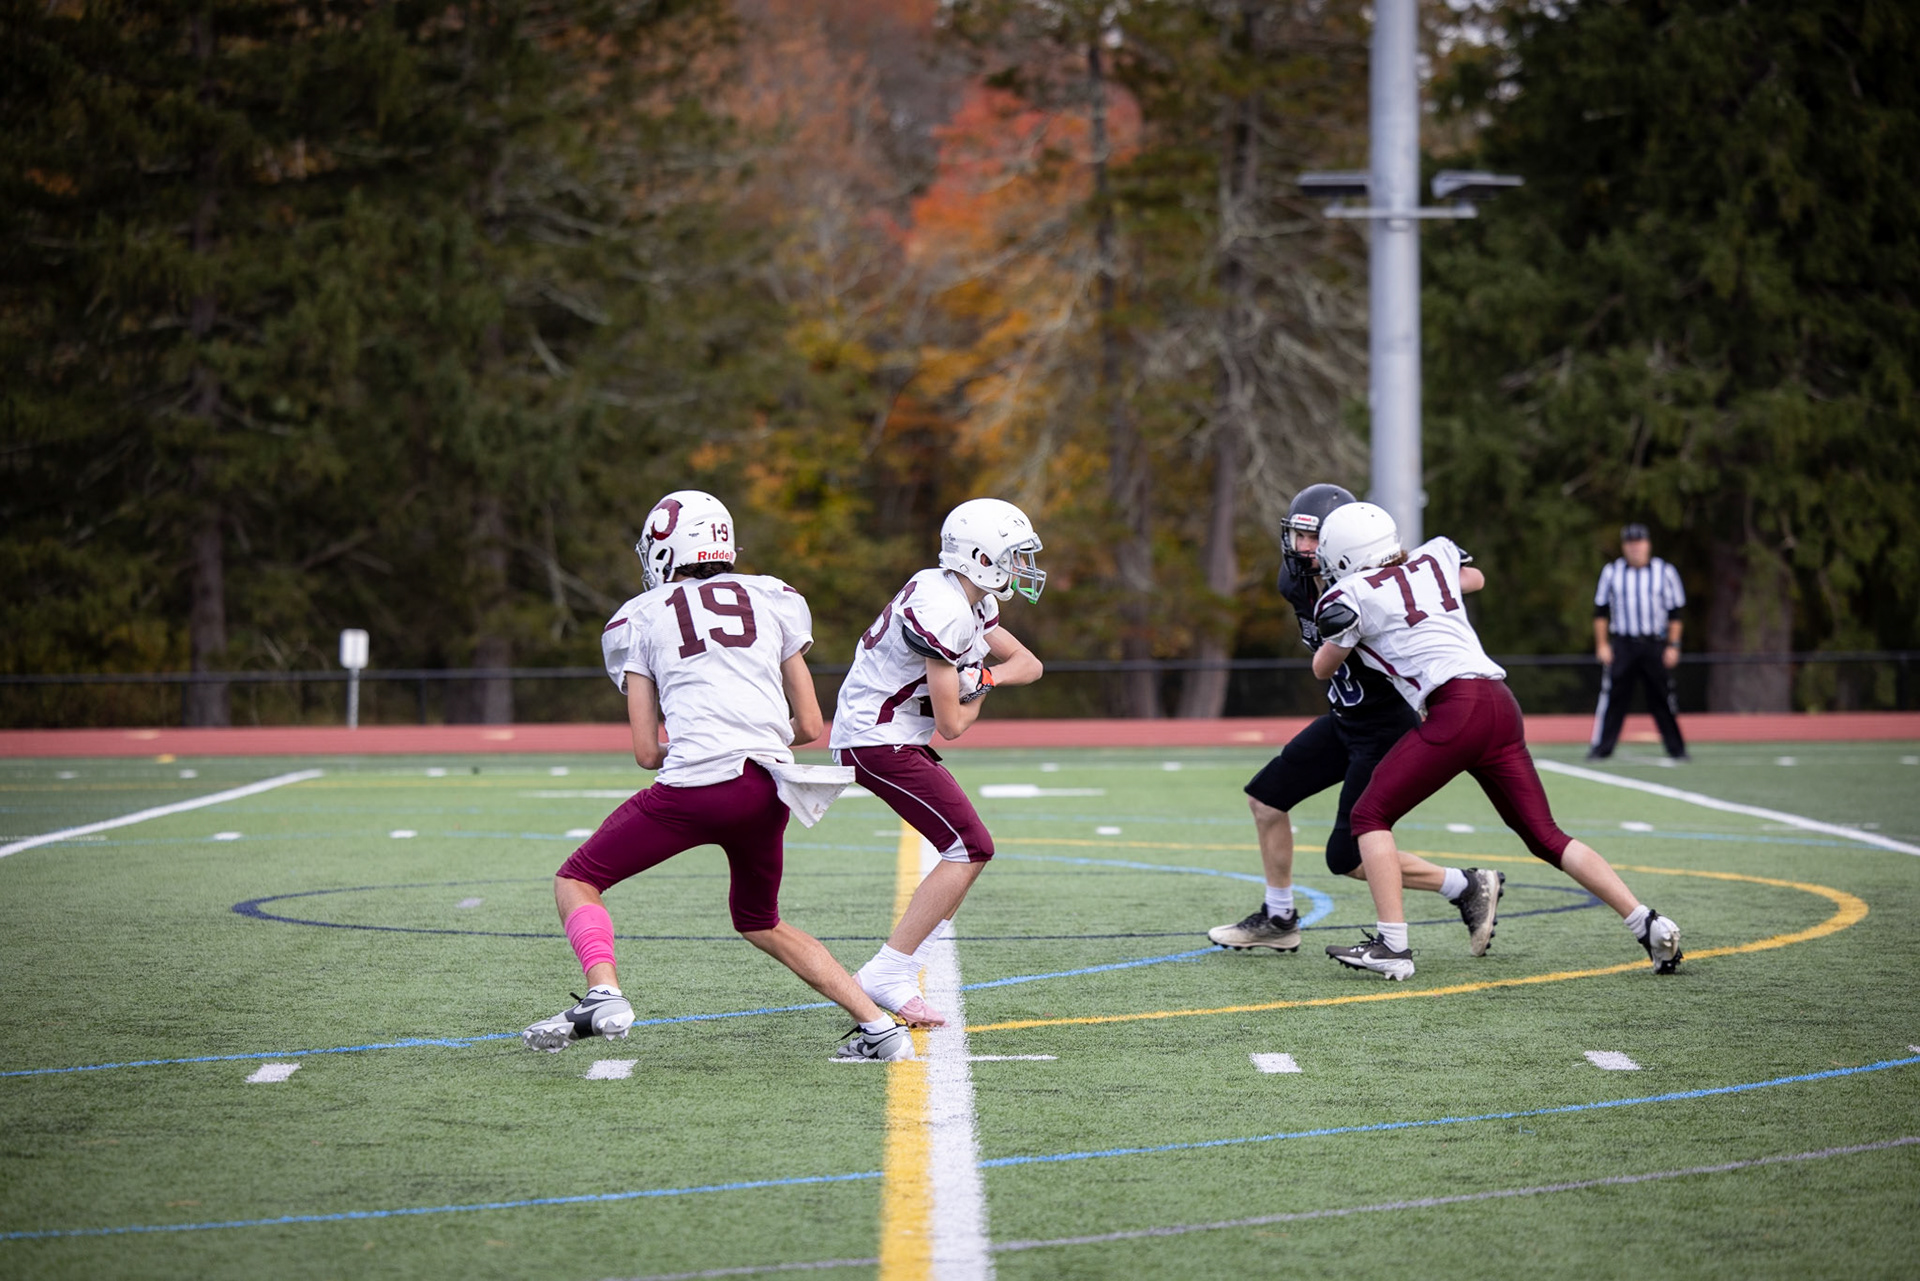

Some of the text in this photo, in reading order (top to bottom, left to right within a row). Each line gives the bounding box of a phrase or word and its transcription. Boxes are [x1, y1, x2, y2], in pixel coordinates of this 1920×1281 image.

[711, 523, 728, 542] 19
[664, 581, 758, 659] 19
[1365, 554, 1460, 628] 77
